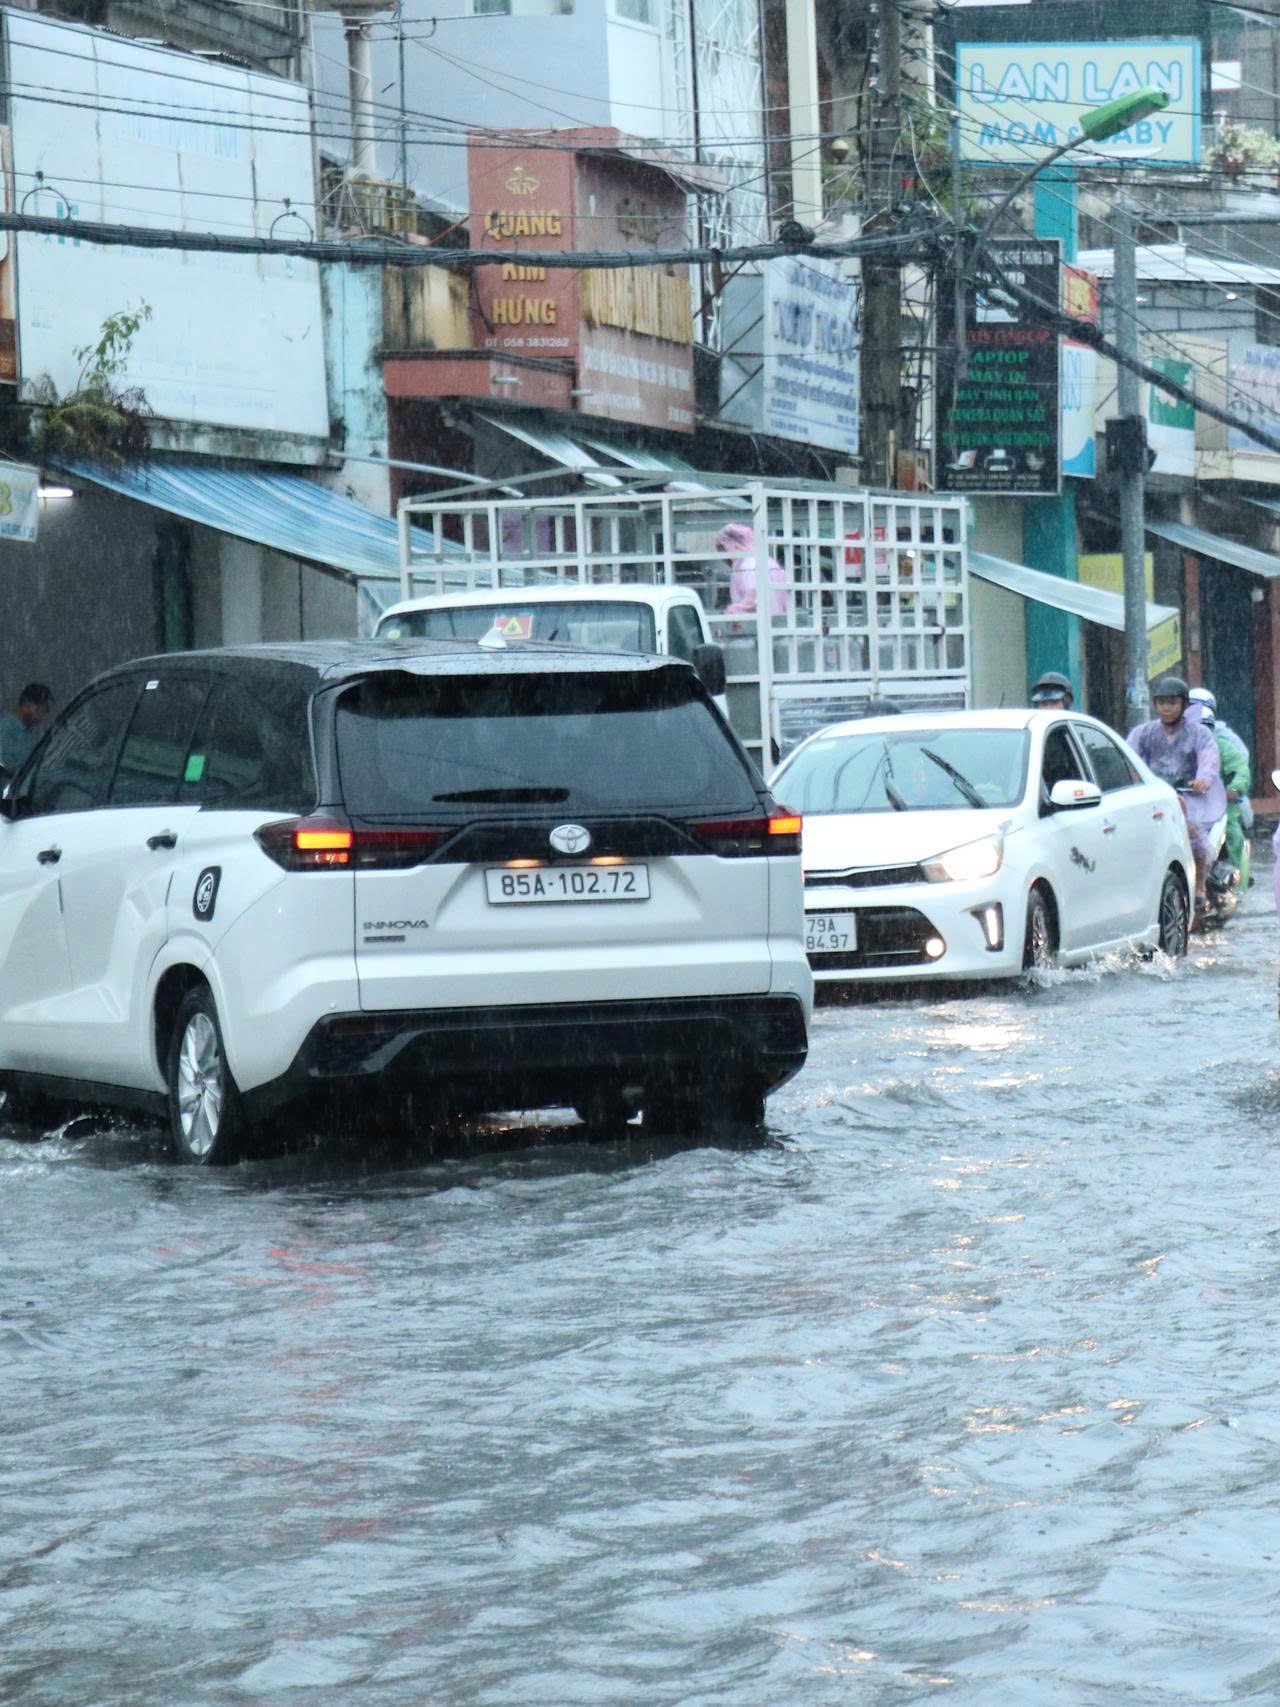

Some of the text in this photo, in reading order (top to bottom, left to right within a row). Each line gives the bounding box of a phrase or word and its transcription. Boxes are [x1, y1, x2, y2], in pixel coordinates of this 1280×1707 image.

[970, 61, 1183, 103] LAN LAN
[979, 121, 1057, 146] MOM
[1094, 120, 1173, 144] ABY
[485, 209, 562, 240] QUANG
[492, 294, 557, 325] HƯNG
[967, 350, 1030, 363] LAPTOP
[501, 871, 637, 897] 85A-102.72
[363, 919, 430, 930] INNOVA
[806, 918, 835, 933] 79A
